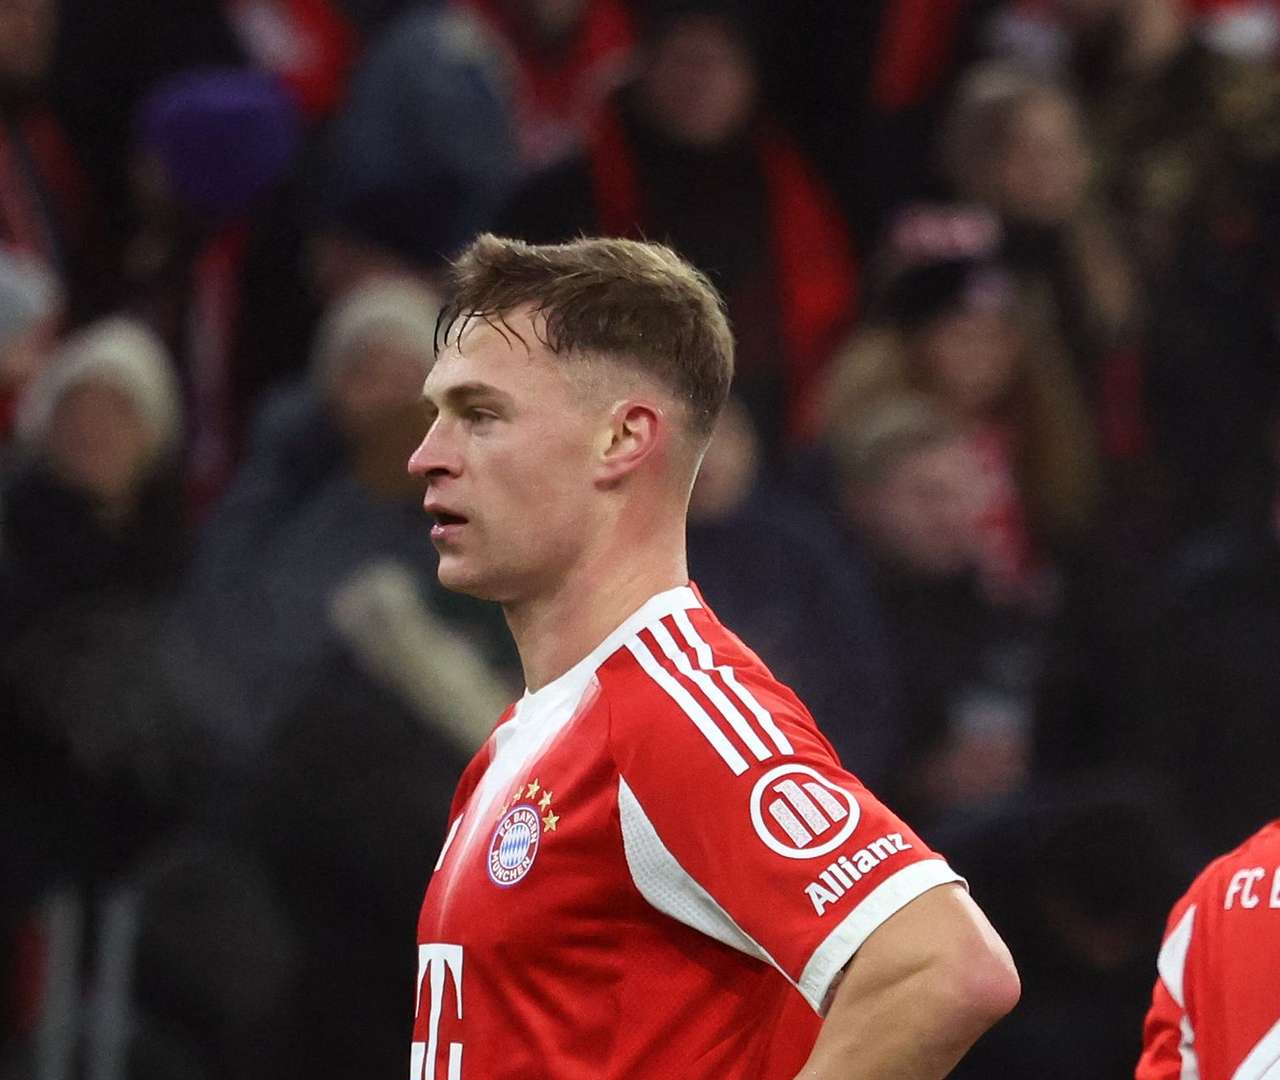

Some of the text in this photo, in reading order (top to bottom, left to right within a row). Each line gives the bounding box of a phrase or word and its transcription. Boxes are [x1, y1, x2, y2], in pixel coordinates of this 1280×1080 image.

[513, 811, 538, 843] BAYERN
[804, 832, 913, 917] Allianz
[1223, 866, 1266, 911] FC
